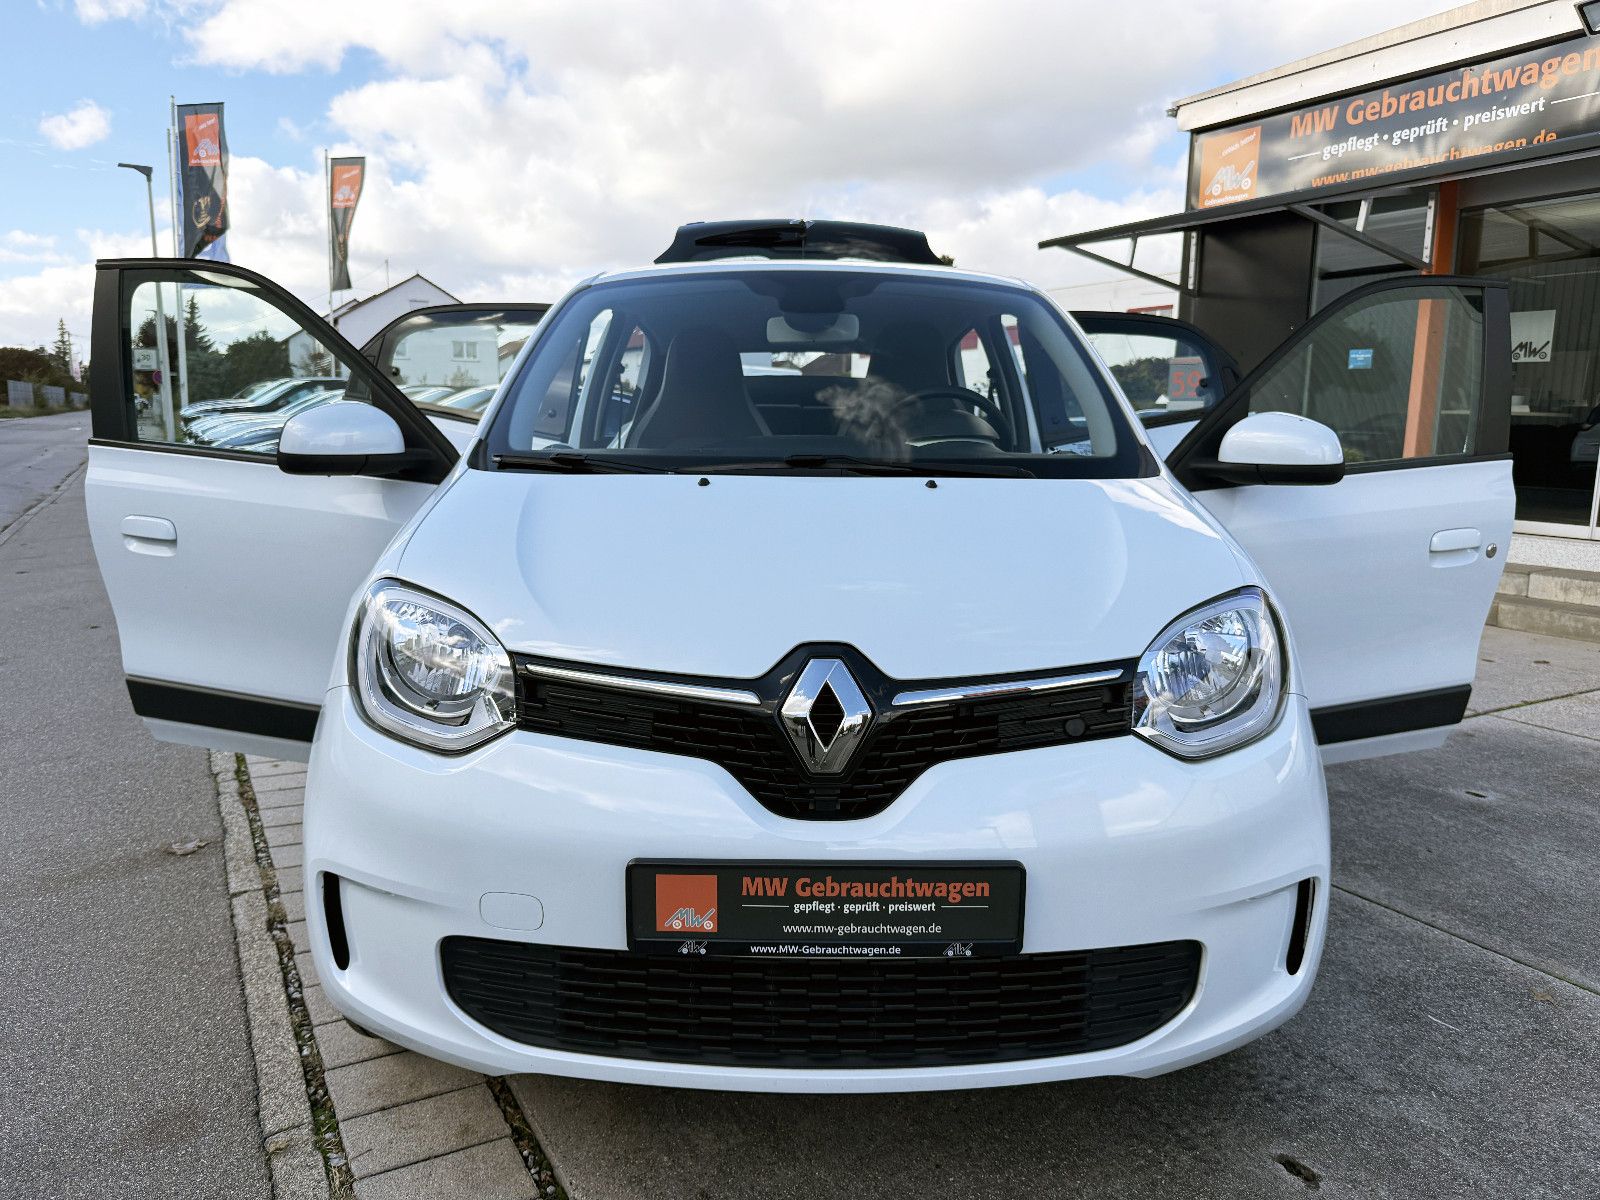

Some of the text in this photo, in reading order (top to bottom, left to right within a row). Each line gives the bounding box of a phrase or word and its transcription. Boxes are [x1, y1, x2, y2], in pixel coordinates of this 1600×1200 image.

[1290, 47, 1600, 139] MW Gebrauchtwagen
[1322, 97, 1546, 160] gepflegt geprüft preiswert
[742, 876, 990, 904] MW Gebrauchtwagen
[793, 901, 936, 915] gepflegt geprüft preiswert
[782, 923, 942, 936] www.mw-gebrauchtwagen.de
[750, 944, 901, 956] www.MW-Gebrauchtwagen.de
